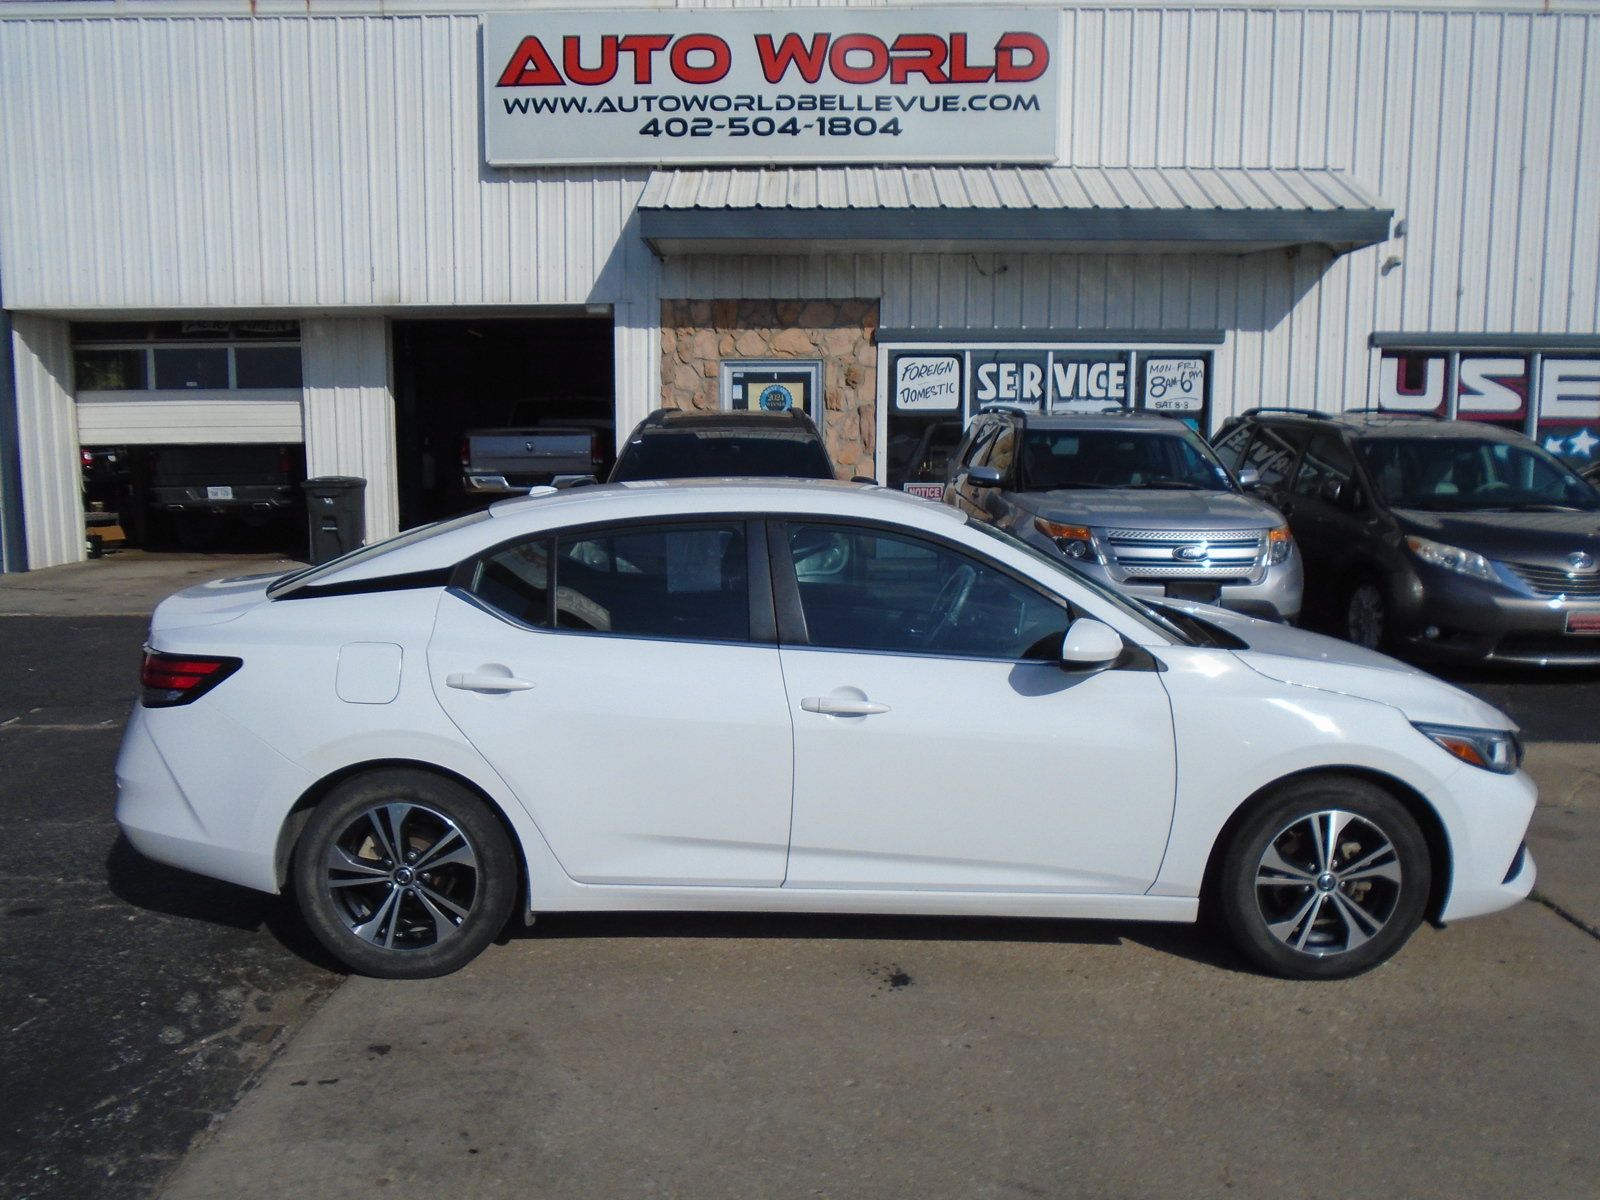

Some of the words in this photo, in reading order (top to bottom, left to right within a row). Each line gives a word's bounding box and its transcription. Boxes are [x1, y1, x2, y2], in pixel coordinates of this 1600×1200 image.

[496, 33, 731, 87] AUTO
[754, 32, 1050, 84] WORLD
[503, 94, 1041, 115] WWW.AUTOWORLDBELLEVUE.COM
[639, 116, 903, 138] 402-504-1804
[901, 360, 955, 382] FOREIGN
[977, 363, 1126, 400] SERVICE
[900, 382, 955, 404] DOMESTIC
[1155, 401, 1173, 409] SAT
